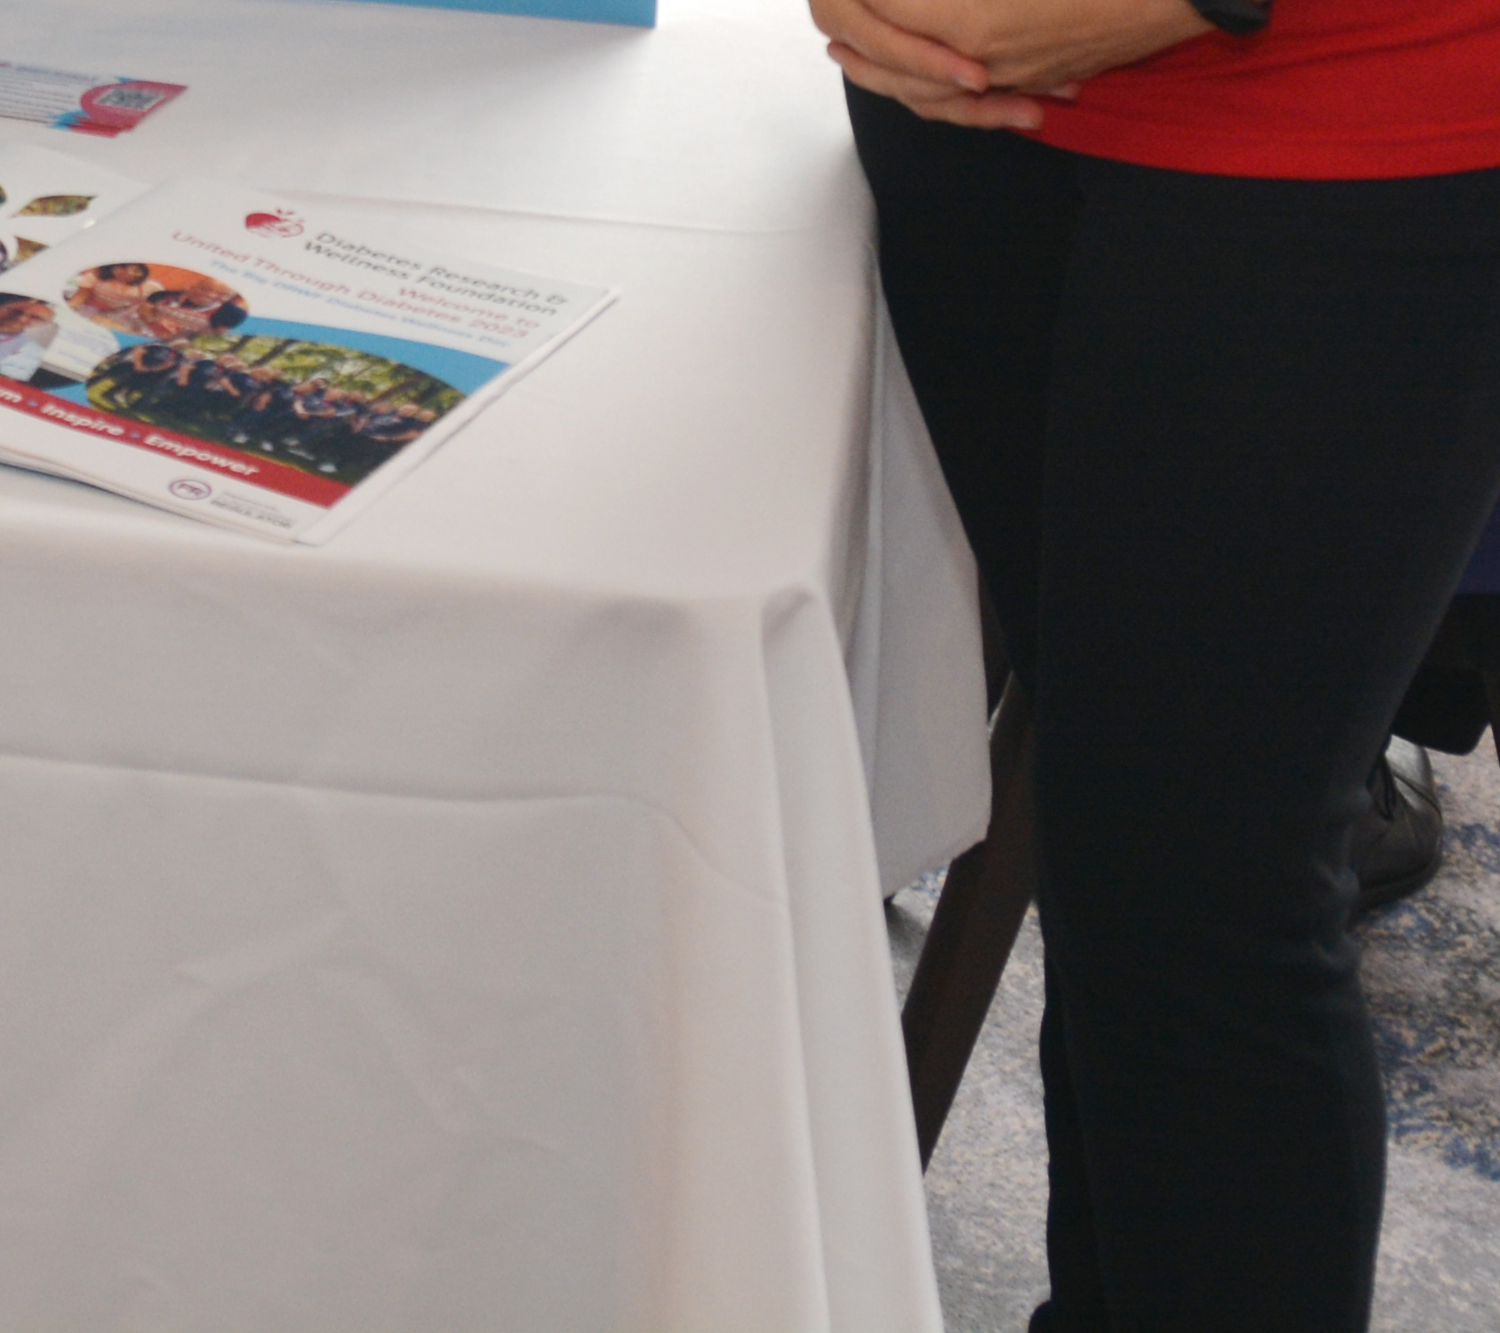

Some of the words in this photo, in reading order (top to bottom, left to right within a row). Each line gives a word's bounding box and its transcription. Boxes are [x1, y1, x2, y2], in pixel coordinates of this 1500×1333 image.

[304, 241, 410, 283] Wellness
[418, 276, 558, 316] Foundation
[316, 231, 422, 272] Diabetes
[431, 265, 541, 301] Research
[40, 401, 125, 438] Inspire
[144, 434, 258, 478] Empower
